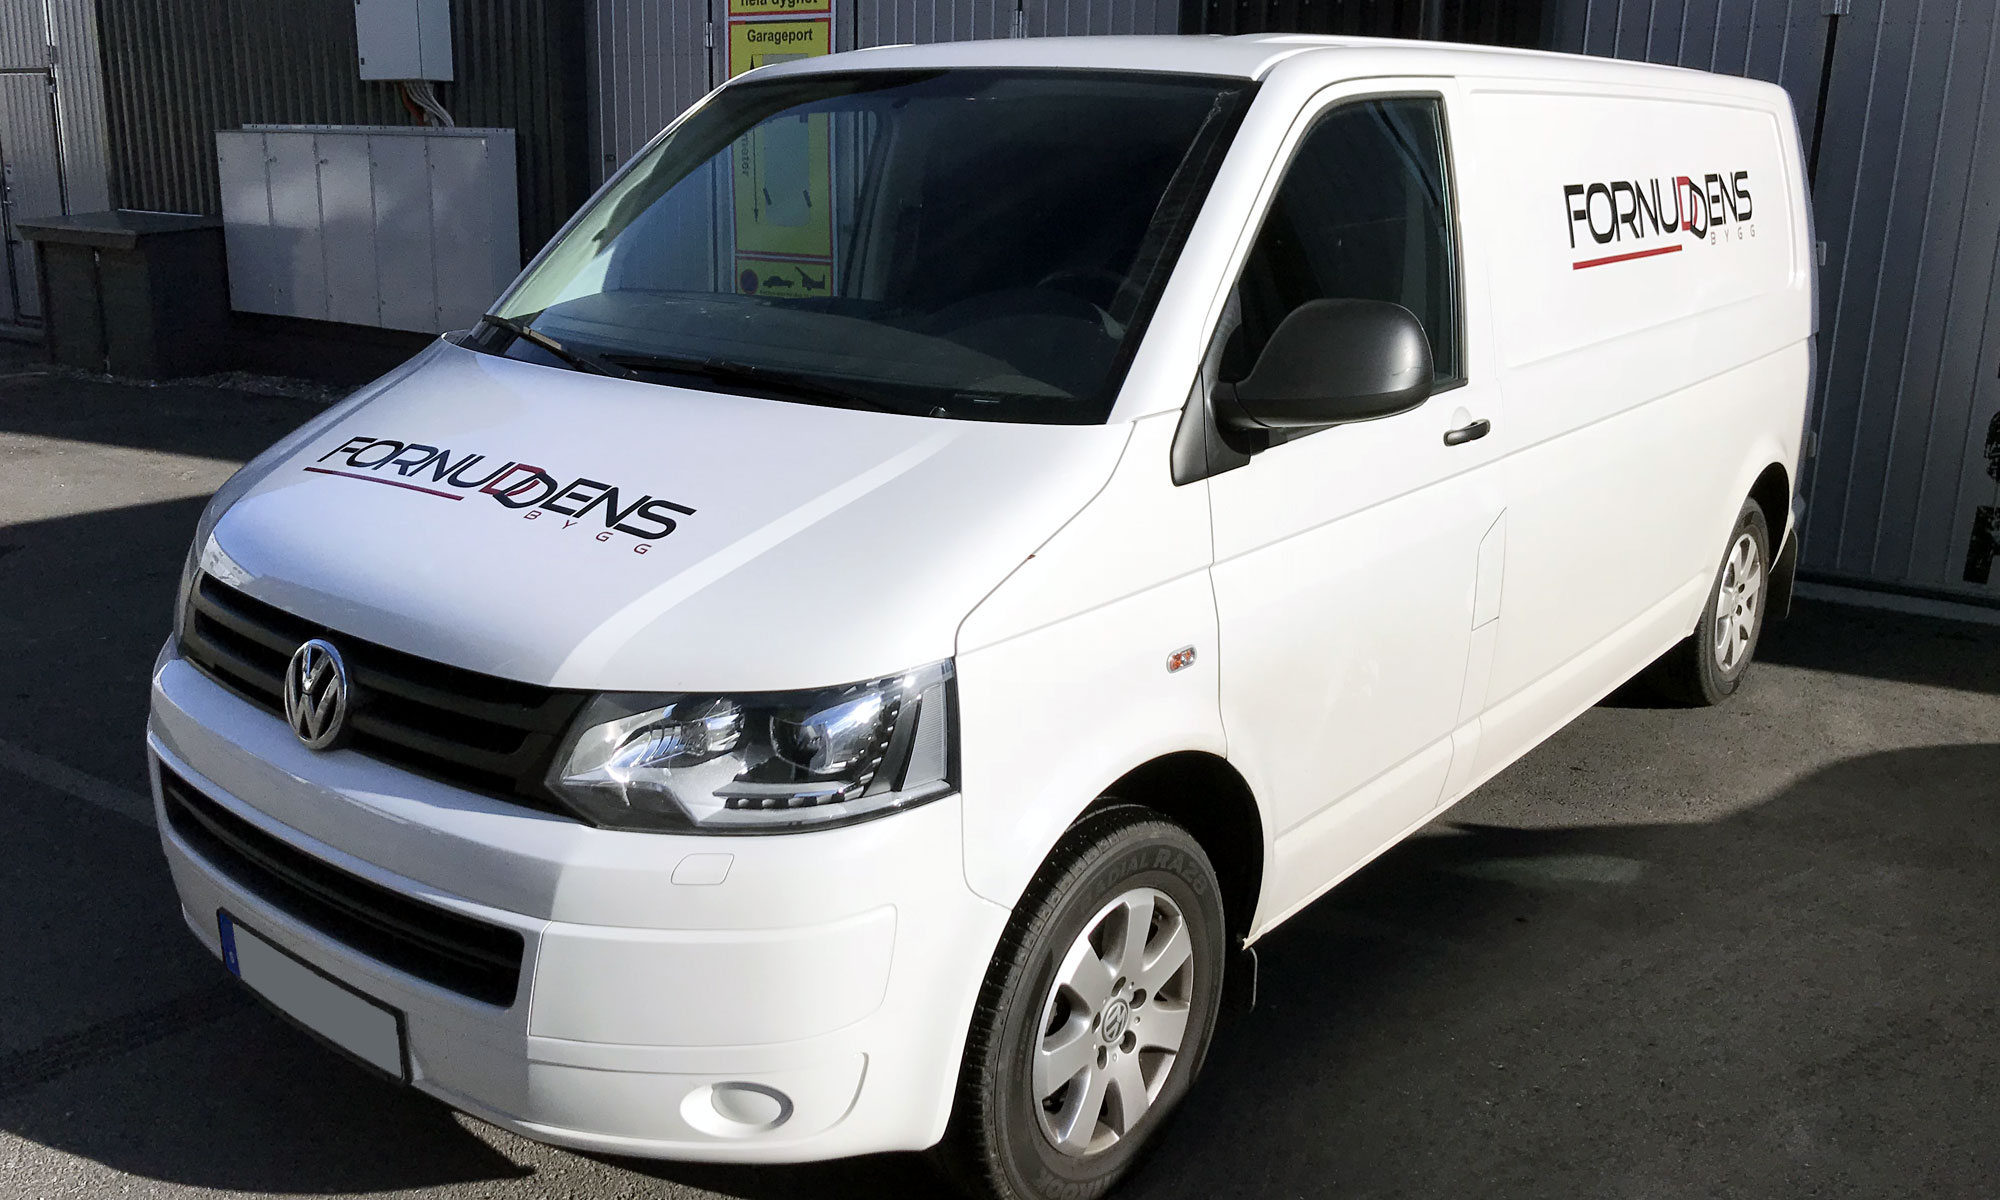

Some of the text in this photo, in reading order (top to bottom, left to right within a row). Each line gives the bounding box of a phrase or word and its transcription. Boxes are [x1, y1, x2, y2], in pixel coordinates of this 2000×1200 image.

[747, 28, 813, 45] Garageport
[1563, 171, 1753, 249] FORNUDDENS
[1711, 225, 1756, 245] BYGG
[317, 436, 697, 540] FORNUDDENS
[523, 510, 653, 555] BYGG
